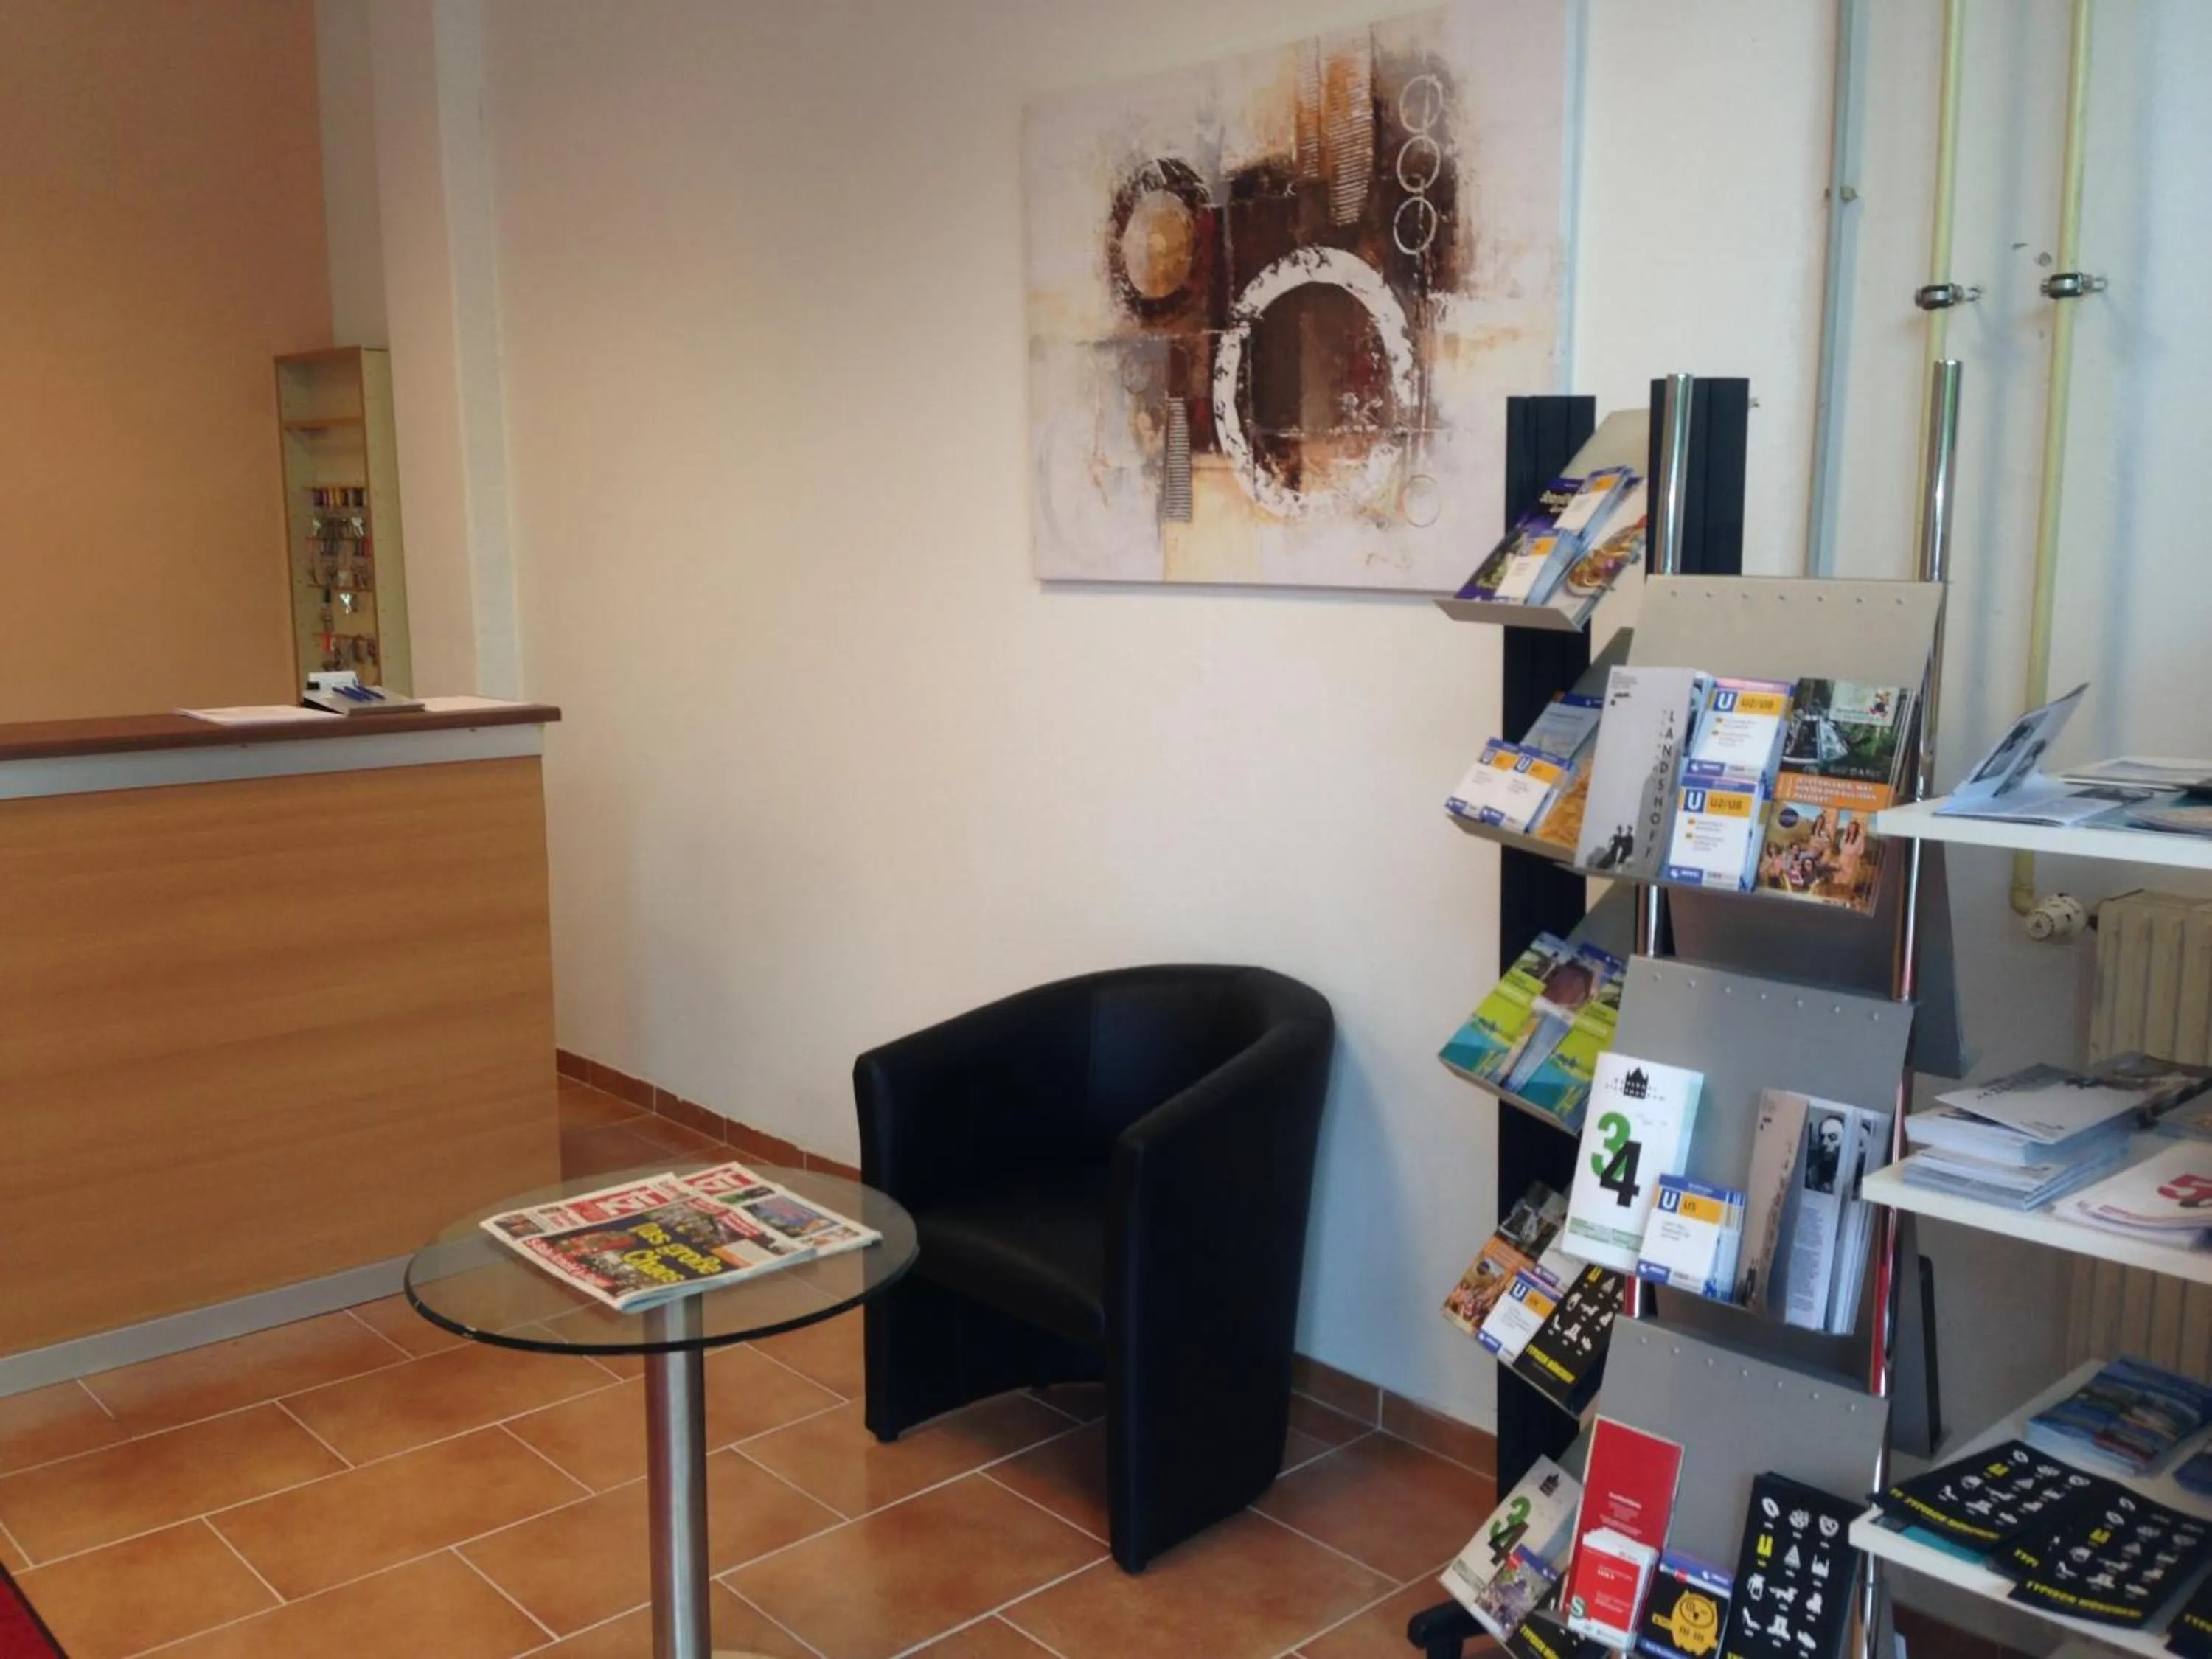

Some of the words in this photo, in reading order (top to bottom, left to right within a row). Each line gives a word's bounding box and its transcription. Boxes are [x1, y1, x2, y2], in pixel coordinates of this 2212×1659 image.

[1718, 692, 1733, 709] U
[1687, 790, 1703, 810] U
[1662, 1190, 1677, 1210] U
